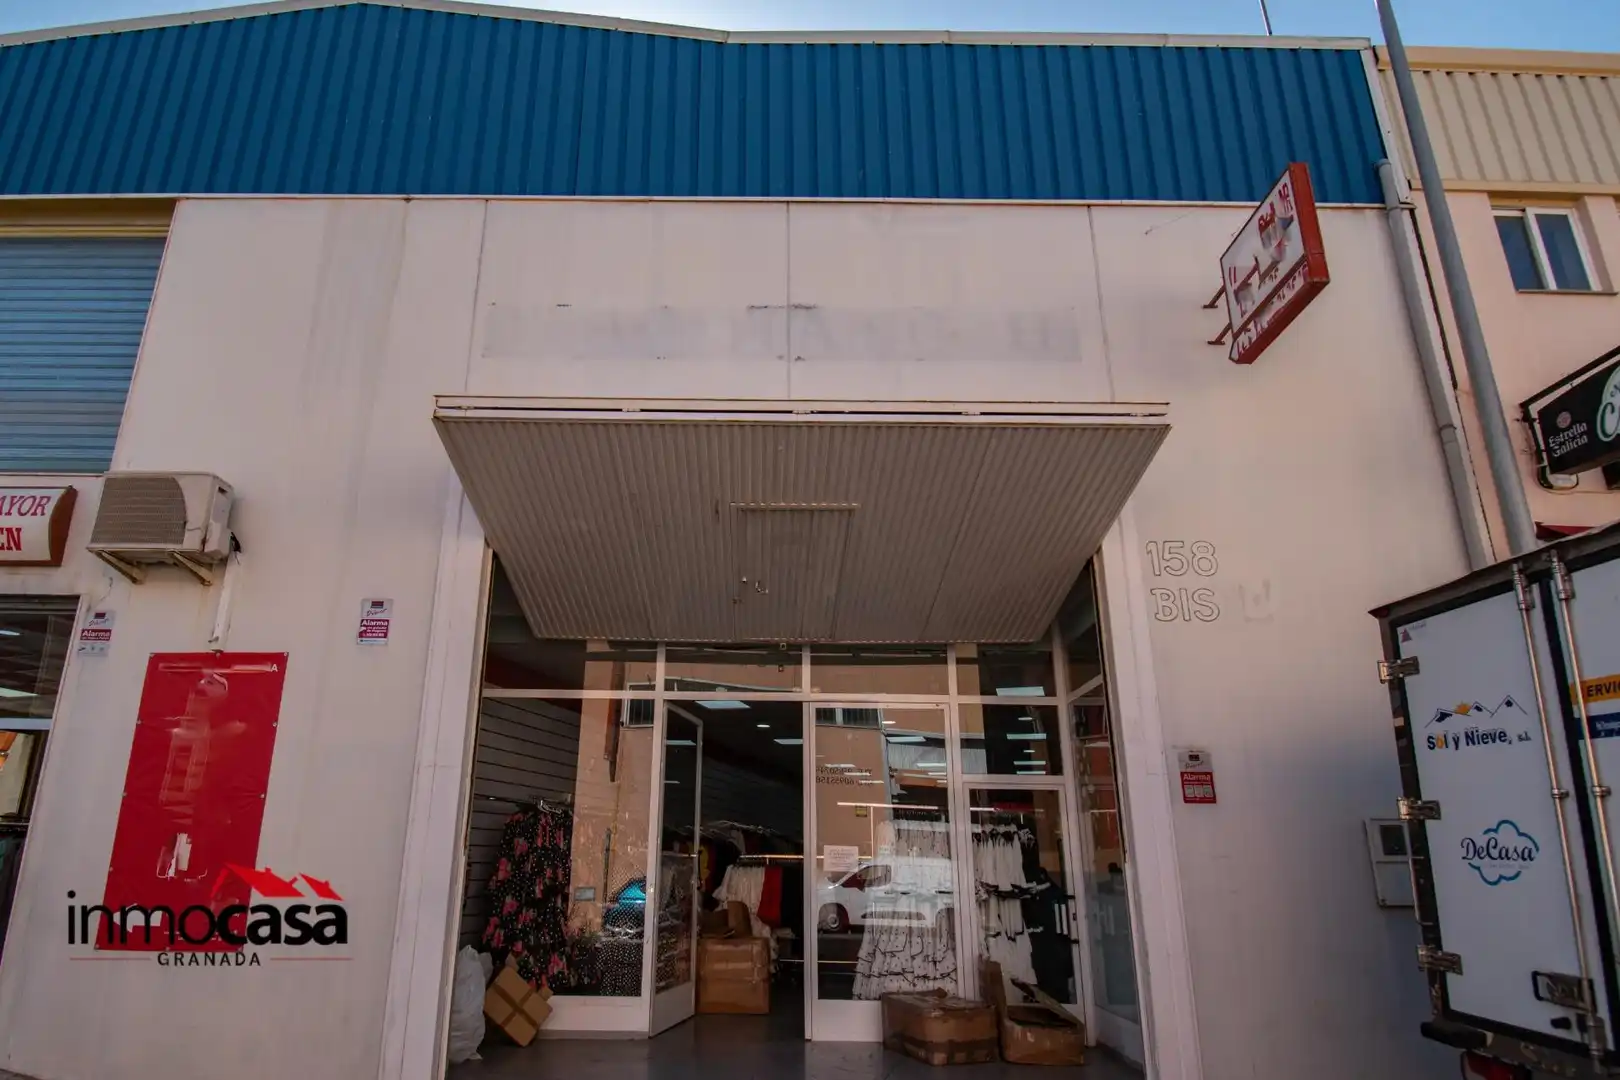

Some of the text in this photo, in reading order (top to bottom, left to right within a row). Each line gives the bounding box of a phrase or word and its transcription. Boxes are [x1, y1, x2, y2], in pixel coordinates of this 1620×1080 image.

[1549, 422, 1588, 447] Estrella
[1551, 434, 1588, 457] Galicia
[1146, 540, 1218, 577] 158
[1150, 587, 1220, 623] BIS
[1580, 680, 1620, 698] ERVI
[1452, 734, 1460, 751] y
[1461, 837, 1536, 862] DeCasa
